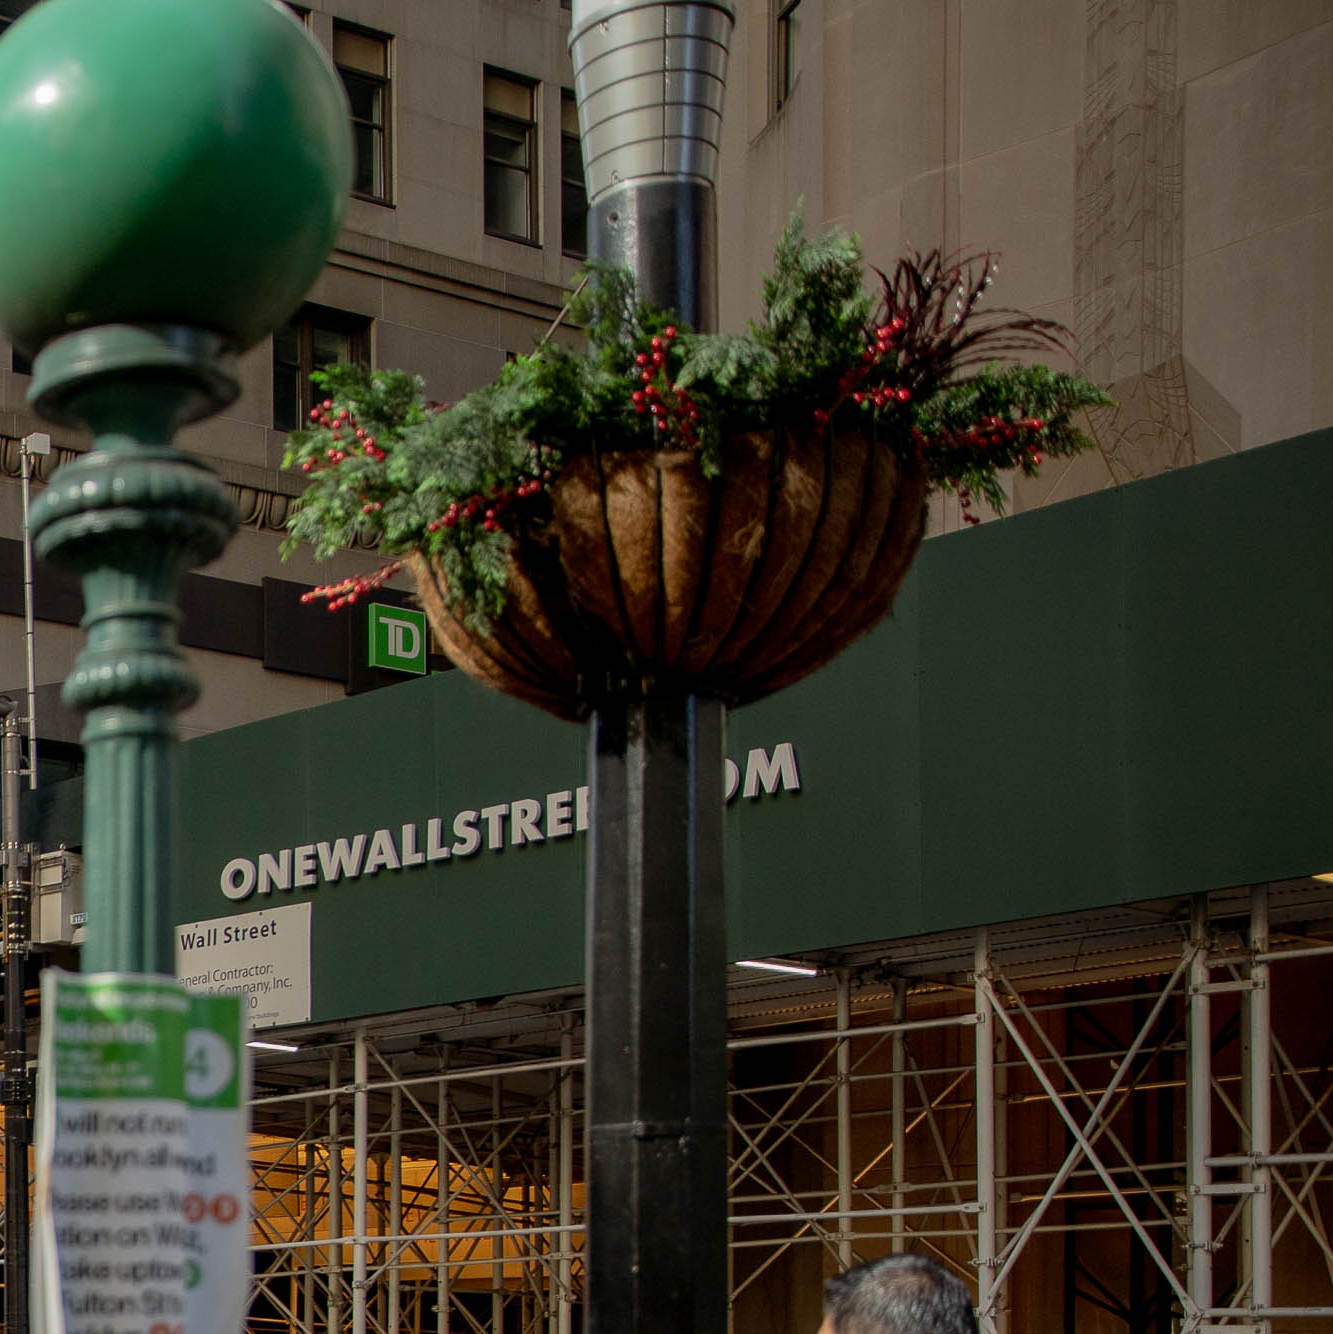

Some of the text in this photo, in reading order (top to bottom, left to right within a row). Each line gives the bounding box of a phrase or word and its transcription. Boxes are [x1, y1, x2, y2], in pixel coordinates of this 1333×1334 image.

[379, 616, 421, 659] TD
[219, 742, 800, 901] ONEWALLSTREEM
[181, 919, 277, 951] Wall Street
[212, 962, 274, 983] Contractor:
[272, 976, 293, 990] Inc.
